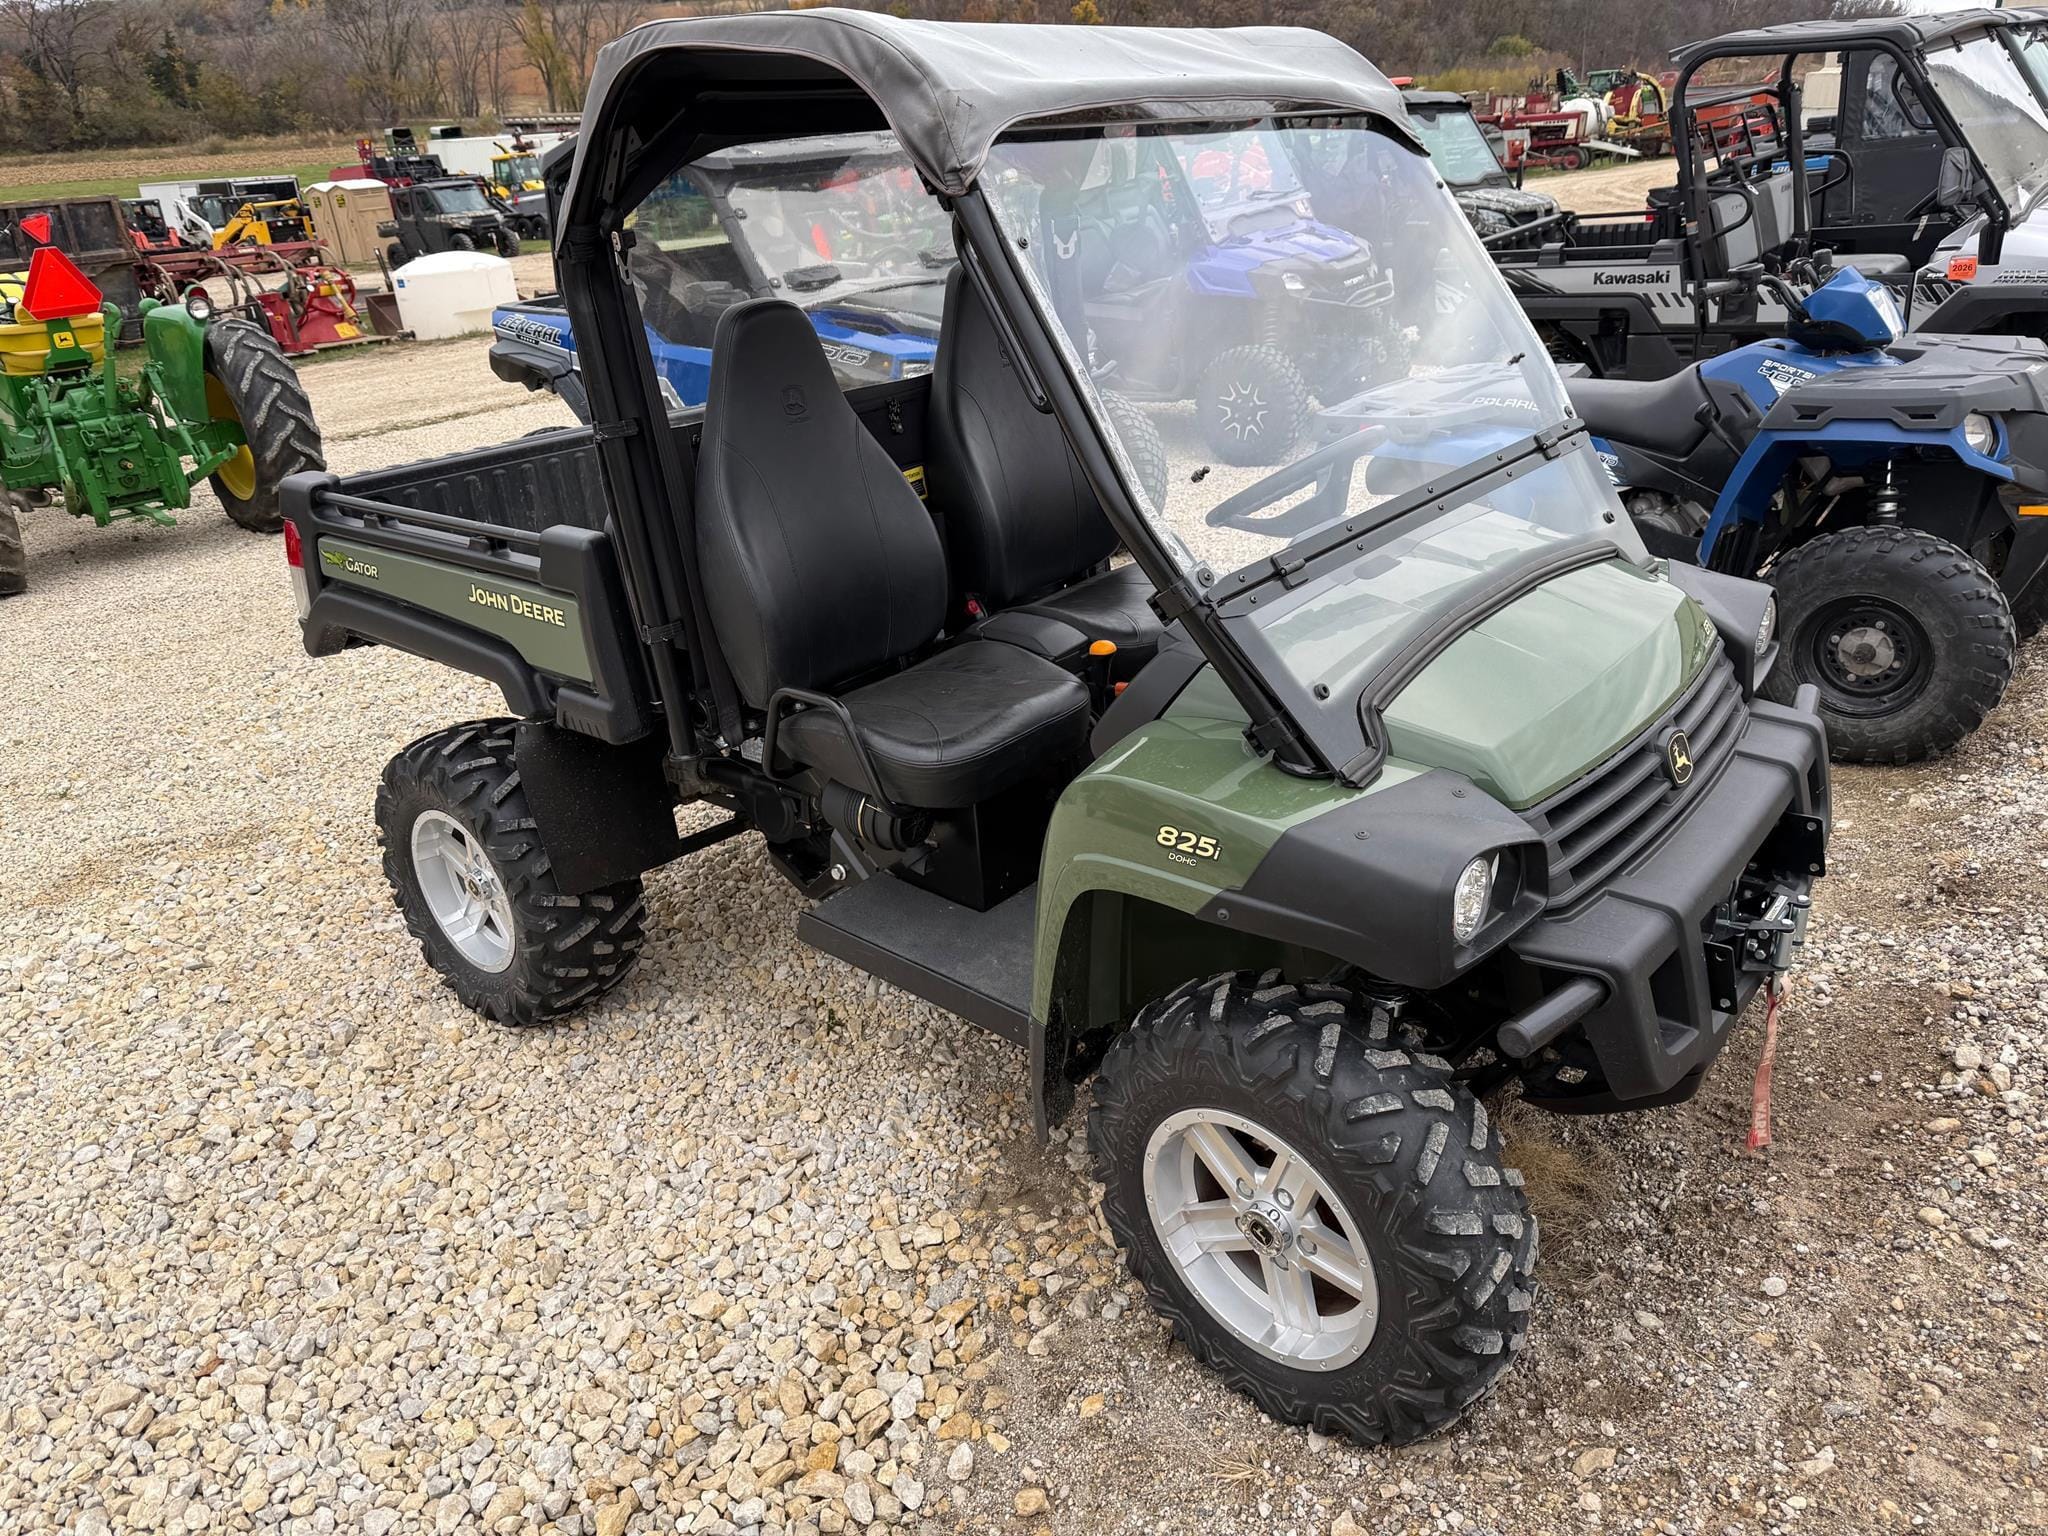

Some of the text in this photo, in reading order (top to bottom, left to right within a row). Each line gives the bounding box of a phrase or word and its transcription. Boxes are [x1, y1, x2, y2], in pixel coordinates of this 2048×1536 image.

[1593, 270, 1670, 285] Kawasaki
[1952, 264, 1973, 272] 2026
[499, 315, 562, 345] GENERAL
[345, 557, 378, 579] GATOR
[468, 583, 565, 627] JOHN DEERE
[1156, 825, 1221, 860] 825i
[1168, 852, 1197, 867] DOHC
[1755, 1100, 1767, 1138] WARN
